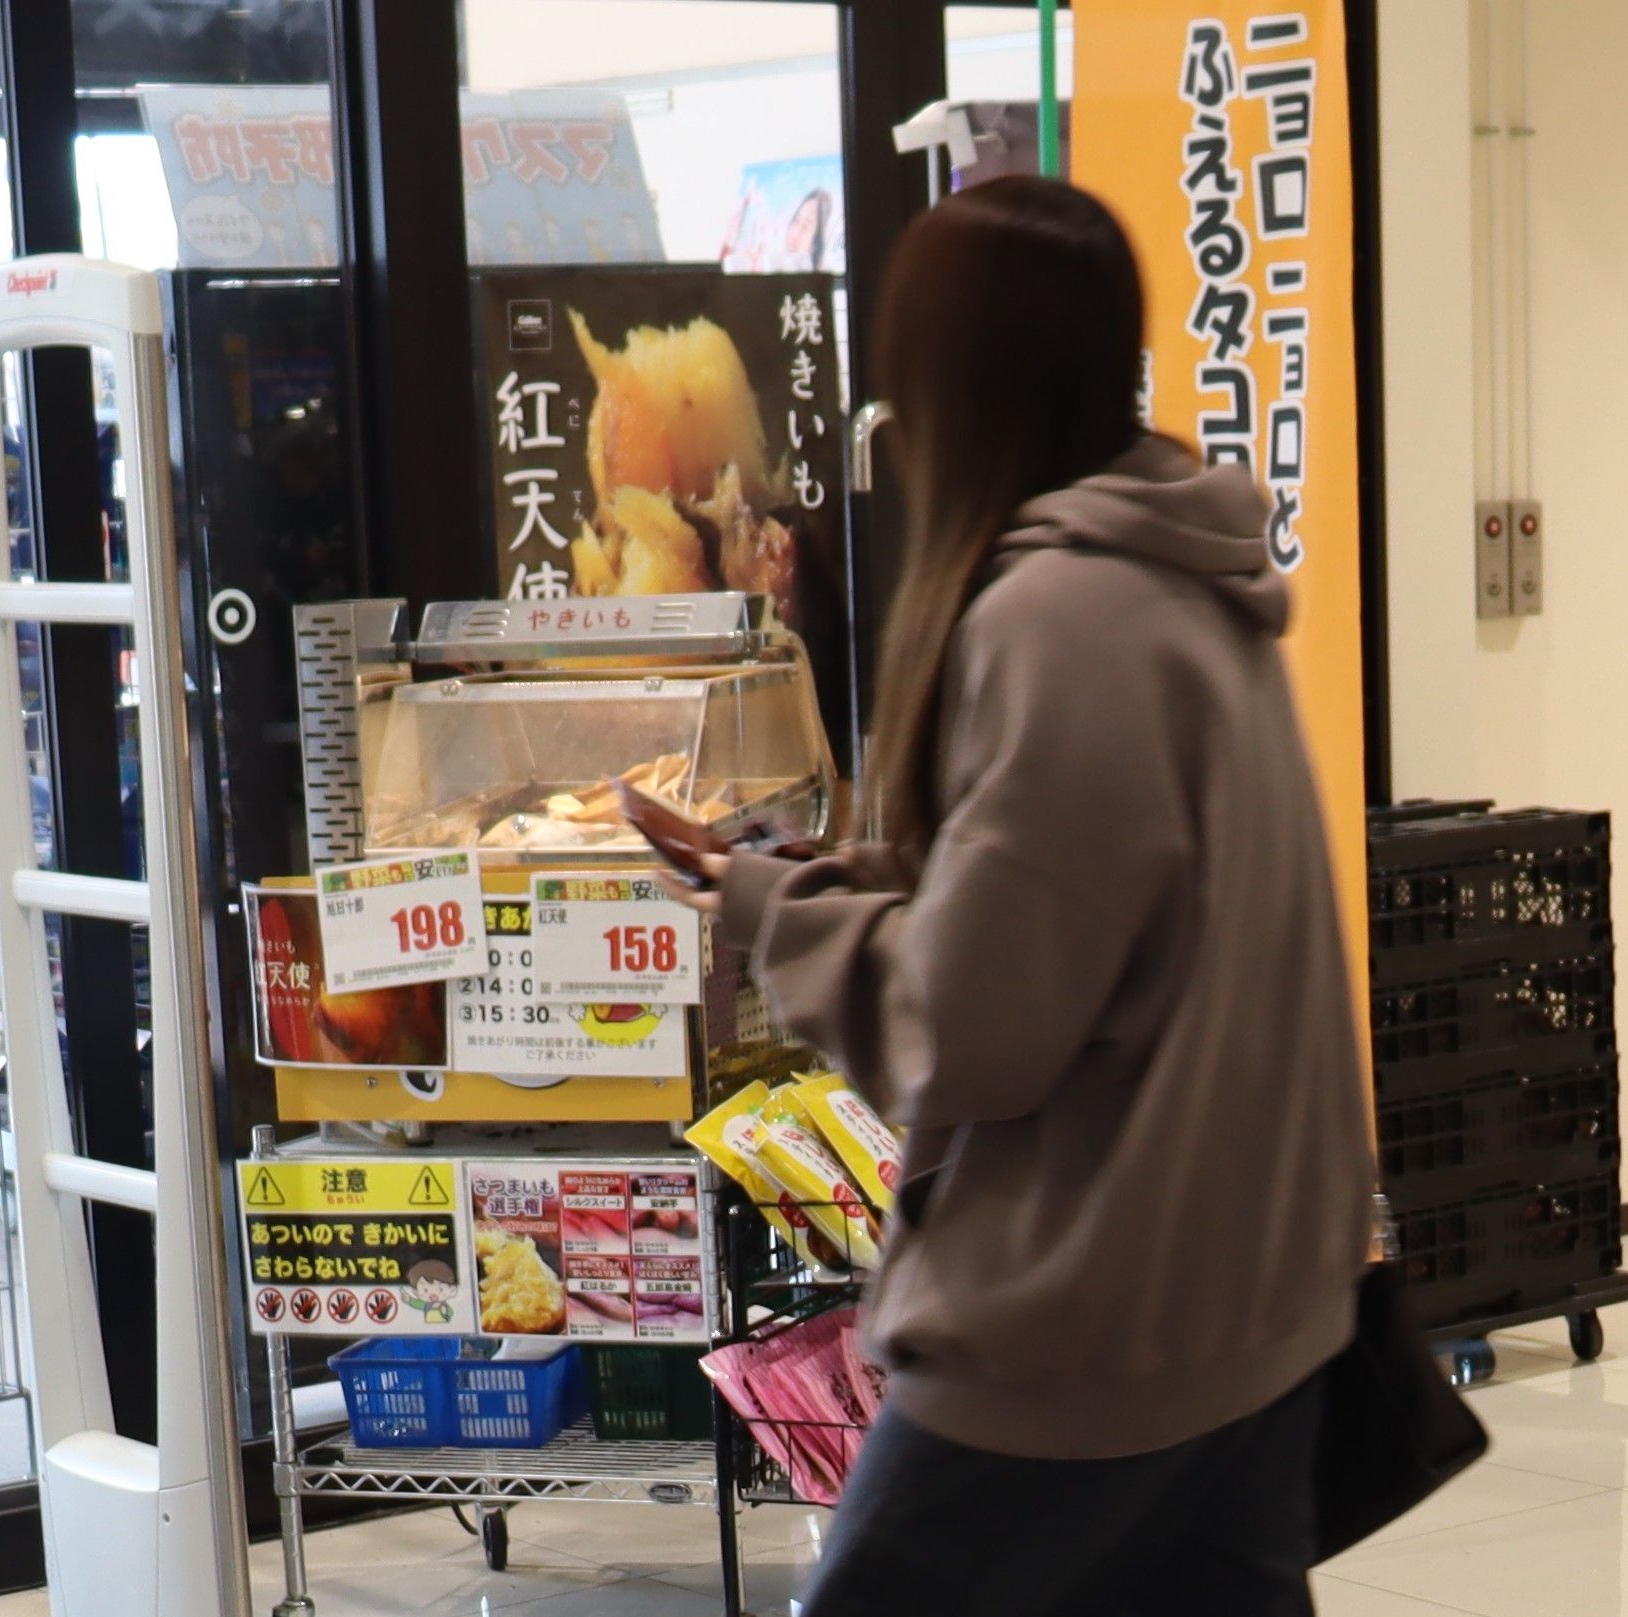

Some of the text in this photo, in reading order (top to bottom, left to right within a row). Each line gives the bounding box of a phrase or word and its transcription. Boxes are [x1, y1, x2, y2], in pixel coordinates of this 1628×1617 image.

[1244, 20, 1313, 568] ニョロニョロと
[779, 294, 827, 510] 焼きいも
[526, 607, 631, 631] やきいも
[390, 900, 465, 953] 198
[603, 925, 678, 973] 158
[321, 1168, 369, 1193] 注意
[473, 1177, 555, 1199] さつまいも
[326, 1194, 365, 1205] ちゅうい
[488, 1196, 541, 1216] 選手権
[565, 1198, 623, 1208] シルクスイート
[250, 1222, 355, 1246] あついので
[363, 1222, 450, 1246] きかいに
[255, 1255, 402, 1279] さわらないでね
